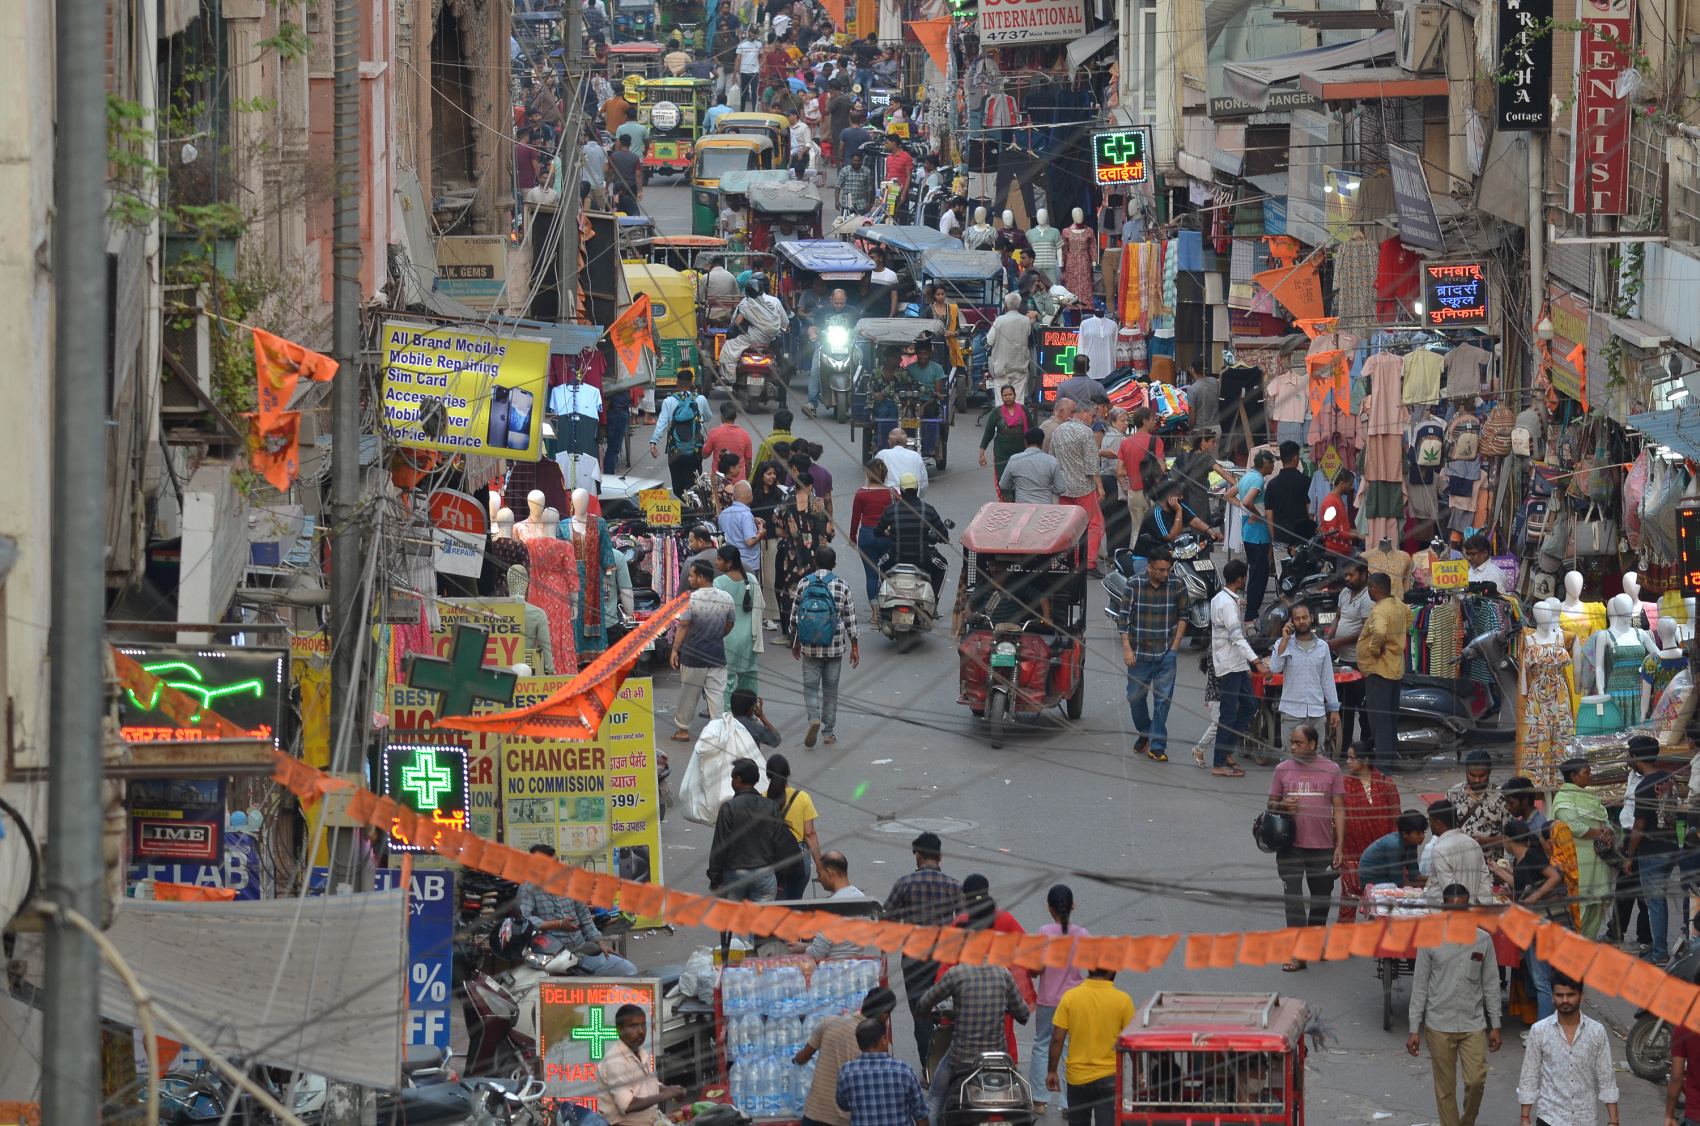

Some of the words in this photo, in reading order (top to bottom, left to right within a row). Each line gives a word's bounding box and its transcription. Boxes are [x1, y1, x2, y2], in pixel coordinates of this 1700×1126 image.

[982, 6, 1082, 30] INTERNATIONAL
[987, 30, 1029, 40] 4737
[1513, 12, 1535, 104] REKHA
[871, 94, 891, 105] दवाई
[1214, 99, 1250, 110] MONE
[1506, 112, 1543, 122] Cottage
[1587, 22, 1620, 210] DENTIST
[1097, 162, 1143, 182] दवाईयाँ
[448, 267, 458, 277] K.
[460, 267, 486, 277] GEMS
[1428, 265, 1484, 280] रामबाबू
[1438, 296, 1475, 308] स्कूल
[390, 331, 408, 345] All
[412, 333, 452, 350] Brand
[455, 338, 506, 356] Mobiles
[389, 350, 433, 367] Mobile
[436, 355, 500, 378] Repairing
[387, 368, 412, 383] Sim
[416, 372, 448, 388] Card
[386, 387, 467, 408] Accessories
[384, 406, 424, 422] Mobil
[382, 424, 426, 442] Mobile
[650, 514, 678, 523] 100/-
[452, 540, 478, 550] MOBILE
[452, 547, 476, 557] REPAIR
[1435, 574, 1466, 584] 100/-
[292, 636, 331, 652] PPROVED
[434, 636, 520, 666] OEY
[516, 682, 540, 693] OVT.
[620, 688, 632, 699] की
[634, 686, 644, 698] भी
[394, 690, 438, 706] BEST
[506, 748, 606, 772] CHANGER
[508, 778, 524, 794] NO
[528, 775, 604, 793] COMMISSION
[154, 828, 204, 840] IME
[612, 820, 624, 832] र्षक
[545, 988, 584, 1004] DELHI
[587, 988, 650, 1004] MEDICOS
[546, 1063, 600, 1082] PHAR
